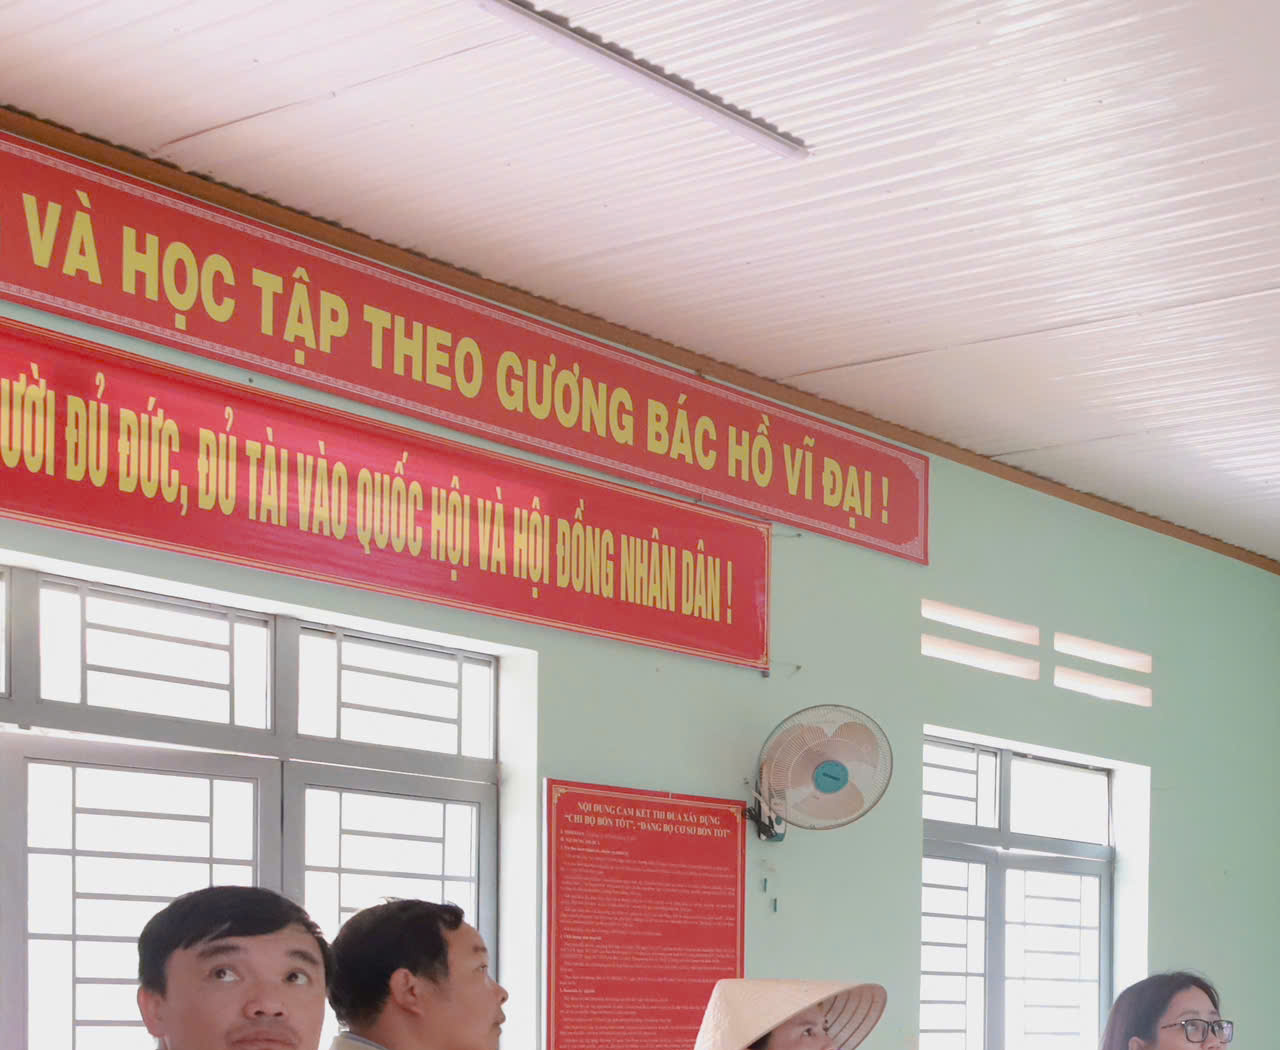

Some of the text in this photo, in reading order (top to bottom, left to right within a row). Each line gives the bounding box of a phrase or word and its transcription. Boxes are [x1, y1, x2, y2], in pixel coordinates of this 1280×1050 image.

[22, 190, 890, 529] VÀ HỌC TẬP THEO GƯƠNG BÁC HỒ VĨ ĐẠI !
[65, 371, 110, 488] ĐỦ
[118, 396, 188, 517] ĐỨC,
[197, 406, 238, 516] ĐỦ
[245, 426, 289, 528] TÀI
[297, 440, 348, 541] VÀO
[357, 451, 423, 557] QUỐC
[430, 475, 471, 582] HỘI
[477, 486, 507, 576] VÀ
[513, 496, 550, 599] HỘI
[556, 498, 615, 600] ĐỒNG
[620, 527, 677, 613] NHÂN
[681, 539, 721, 623] DÂN
[726, 560, 733, 625] !
